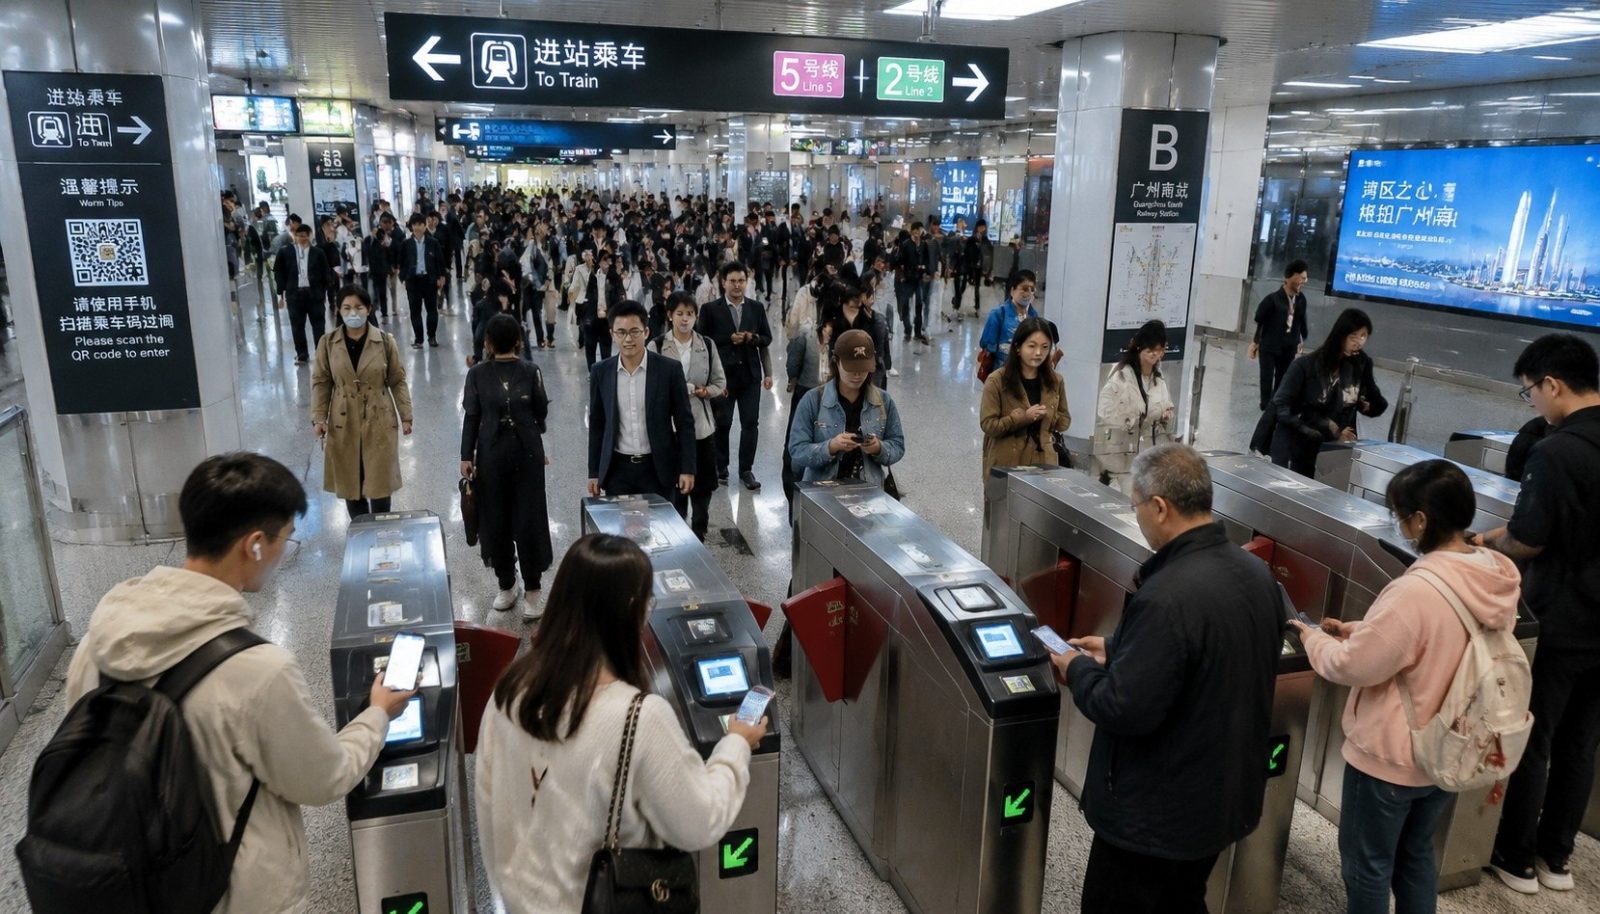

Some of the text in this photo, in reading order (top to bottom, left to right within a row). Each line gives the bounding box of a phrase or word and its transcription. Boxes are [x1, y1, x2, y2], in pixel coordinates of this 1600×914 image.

[534, 38, 646, 70] 进站乘车
[535, 71, 599, 88] To Train
[802, 81, 824, 92] Line
[905, 86, 934, 97] Line 2
[1149, 124, 1178, 171] B
[74, 333, 164, 347] Please scan the
[71, 348, 170, 361] QR code to enter
